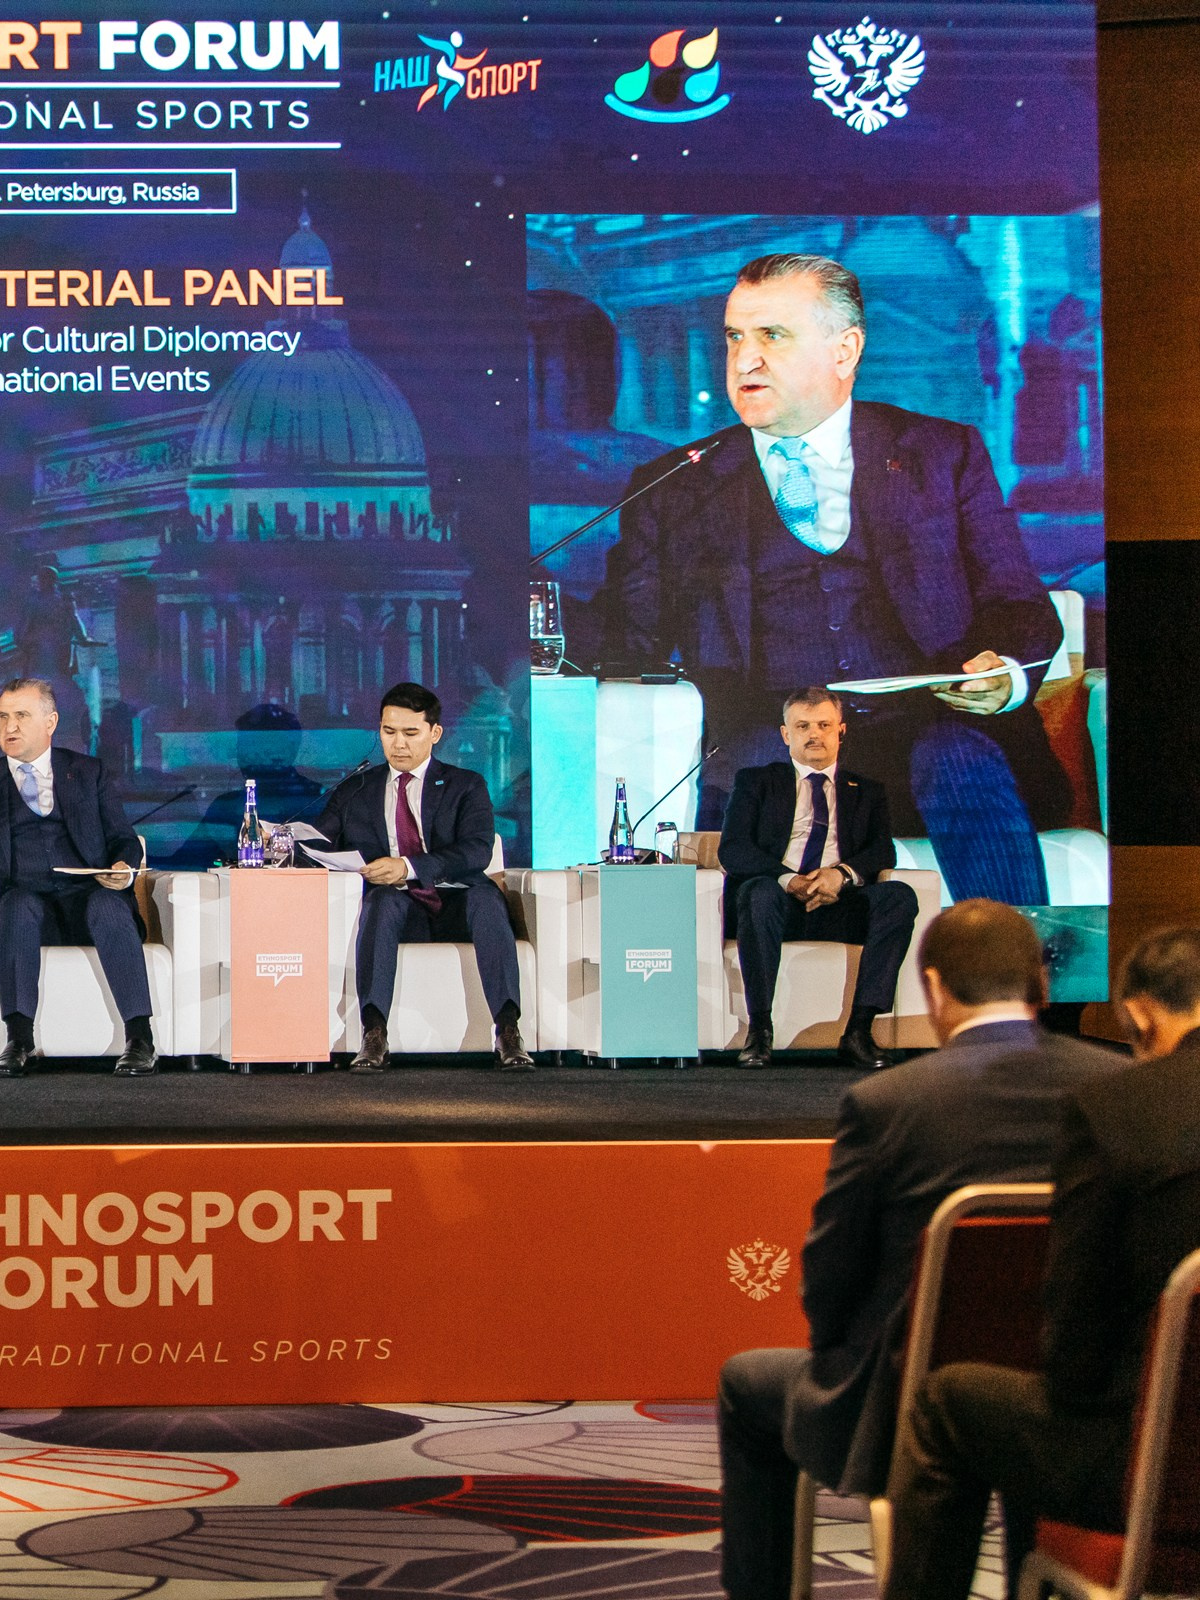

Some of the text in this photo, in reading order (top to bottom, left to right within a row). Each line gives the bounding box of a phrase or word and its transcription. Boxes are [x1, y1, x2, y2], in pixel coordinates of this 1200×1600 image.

[99, 20, 340, 70] FORUM
[374, 55, 542, 99] НАШ СПОРТ
[137, 101, 310, 129] SPORTS
[8, 182, 126, 205] Petersburg,
[134, 182, 200, 201] Russia
[185, 269, 344, 306] PANEL
[22, 326, 134, 353] Cultural
[144, 326, 301, 358] Diplomacy
[112, 366, 211, 391] Events
[261, 965, 299, 973] FORUM
[630, 960, 667, 968] FORUM
[250, 1338, 393, 1362] SPORTS
